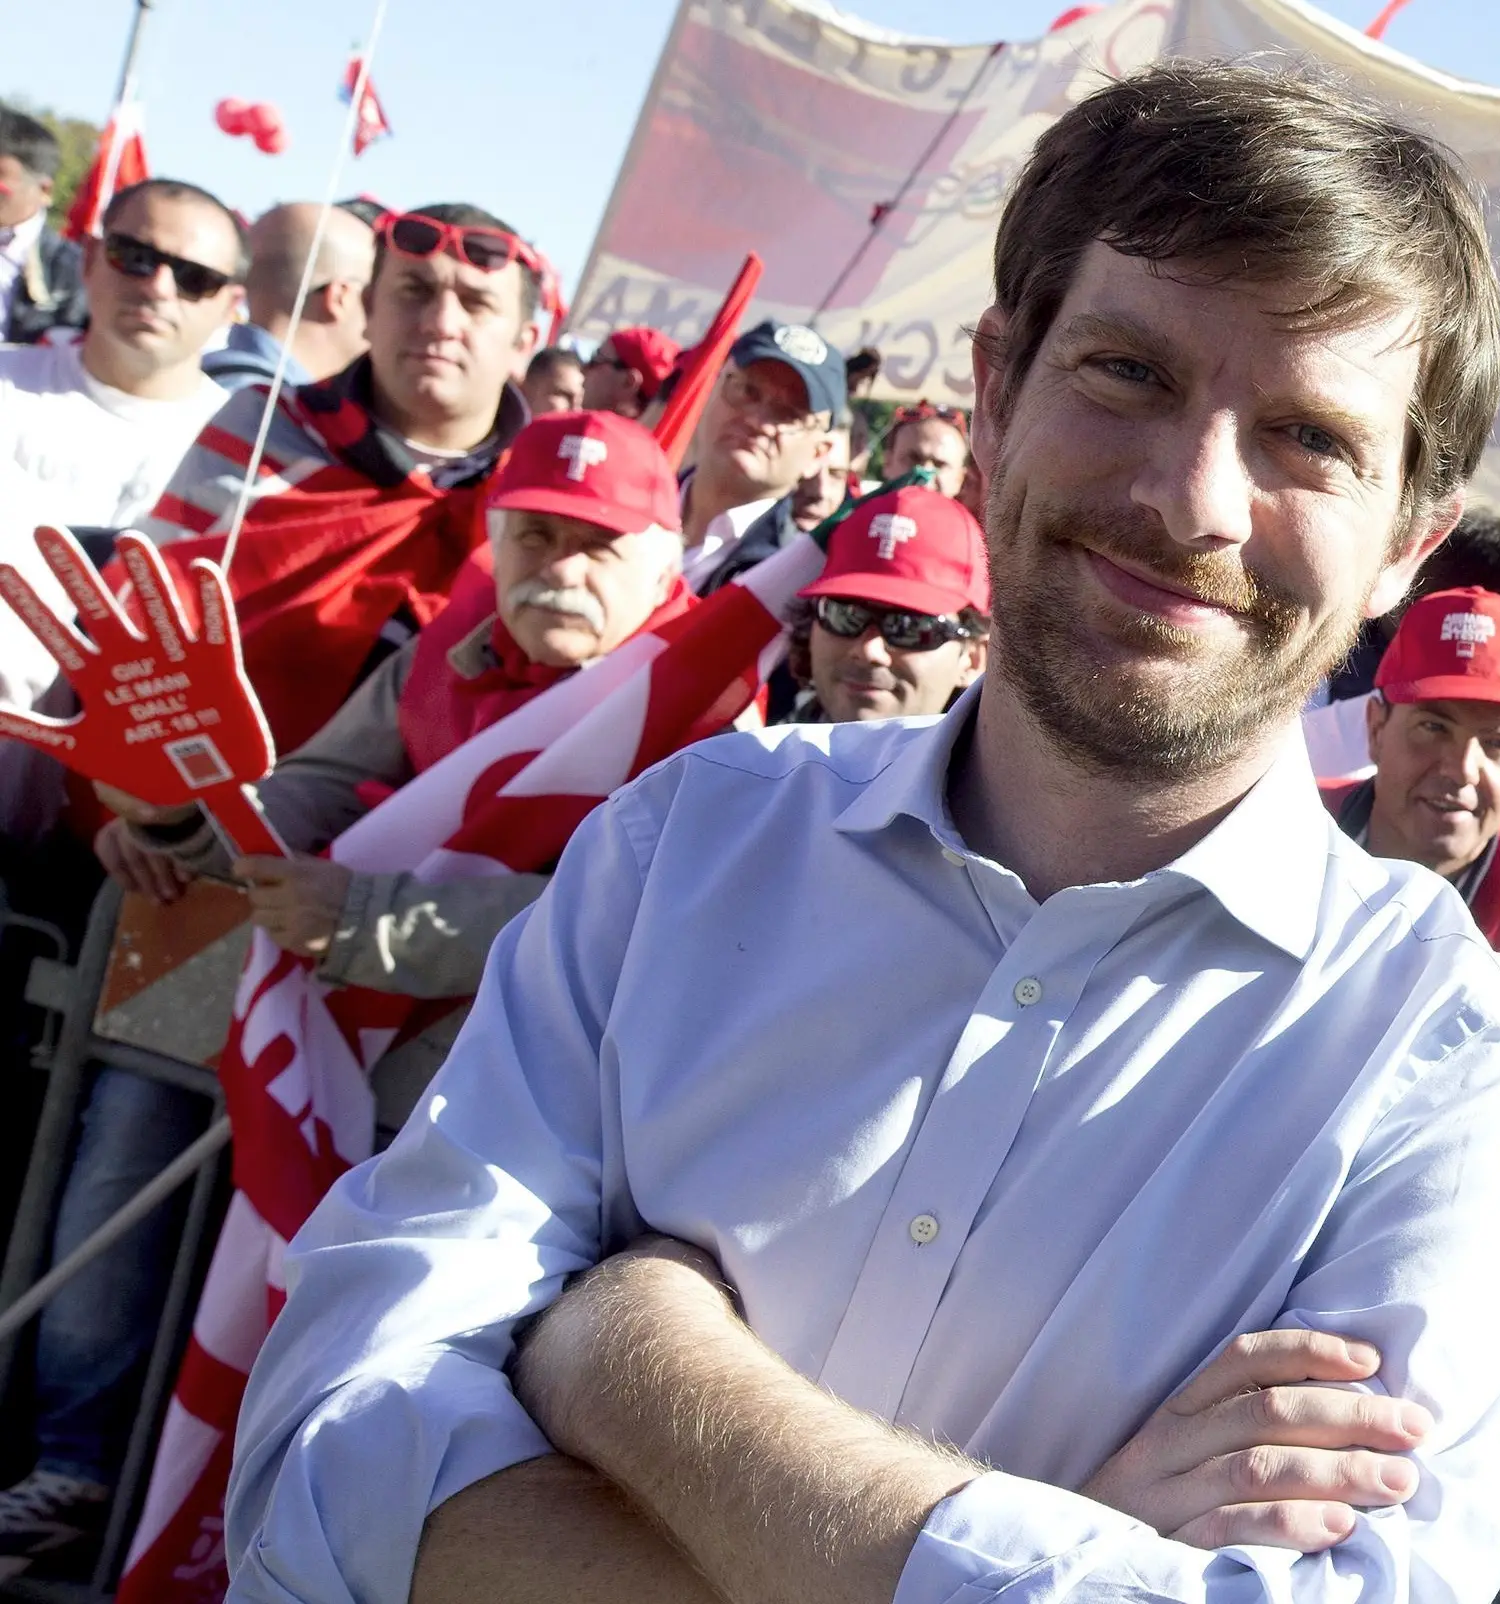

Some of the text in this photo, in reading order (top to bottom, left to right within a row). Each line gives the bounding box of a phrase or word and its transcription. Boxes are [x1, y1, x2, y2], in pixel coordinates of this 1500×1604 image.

[104, 671, 191, 706] LE MANI
[170, 712, 198, 732] 18
